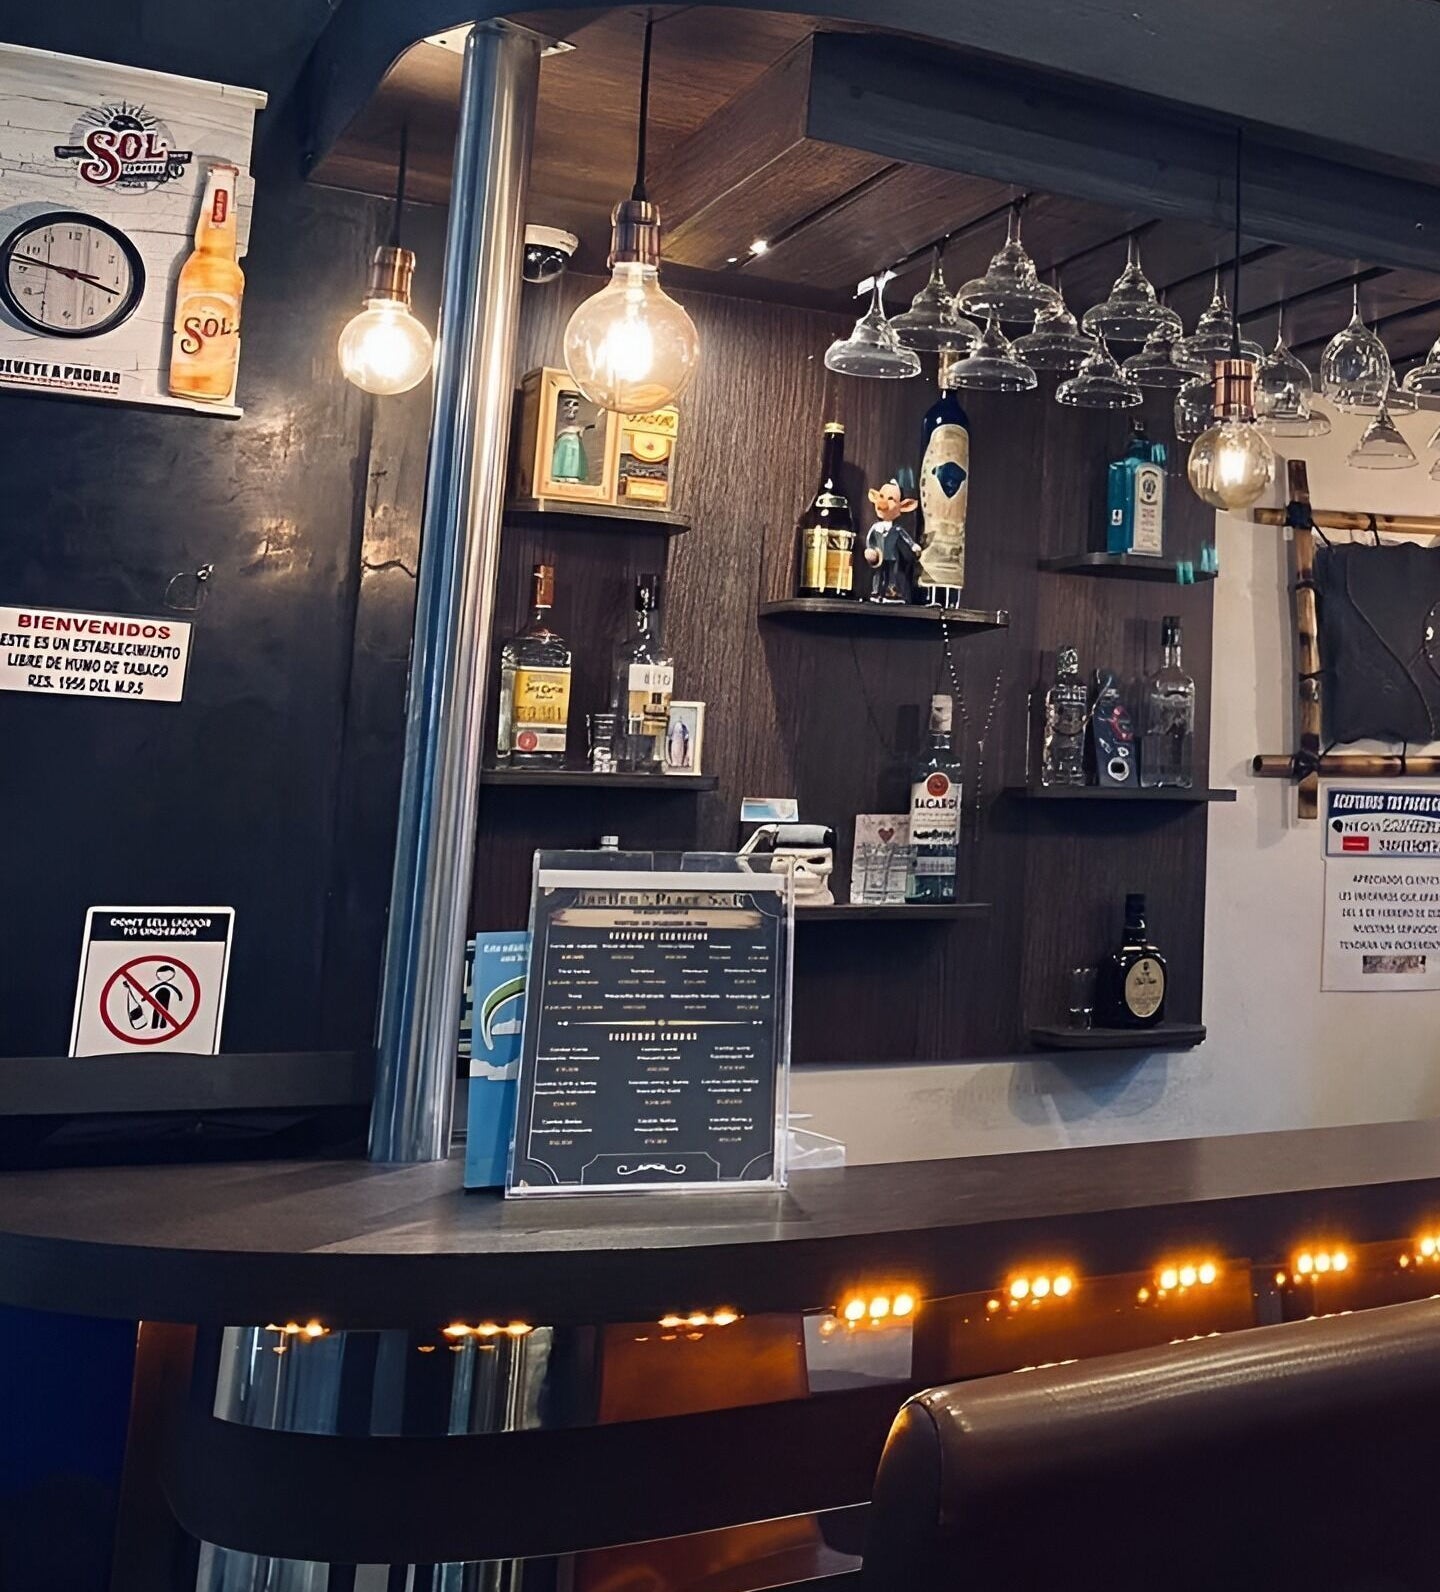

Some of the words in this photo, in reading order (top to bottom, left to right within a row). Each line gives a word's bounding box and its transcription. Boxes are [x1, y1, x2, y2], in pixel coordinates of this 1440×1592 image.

[80, 130, 166, 185] SOL
[180, 316, 232, 354] SOL
[51, 365, 61, 378] A
[17, 614, 171, 640] BIENVENIDOS
[0, 633, 30, 648] ESTE
[34, 636, 49, 650] ES
[52, 637, 71, 651] UN
[73, 639, 181, 659] ESTABLECIMIENTO
[8, 653, 42, 668] LIBRE
[46, 656, 62, 670] DE
[65, 657, 100, 673] HUMO
[104, 660, 119, 674] DE
[123, 662, 169, 677] TABACO
[89, 678, 110, 692] DEL
